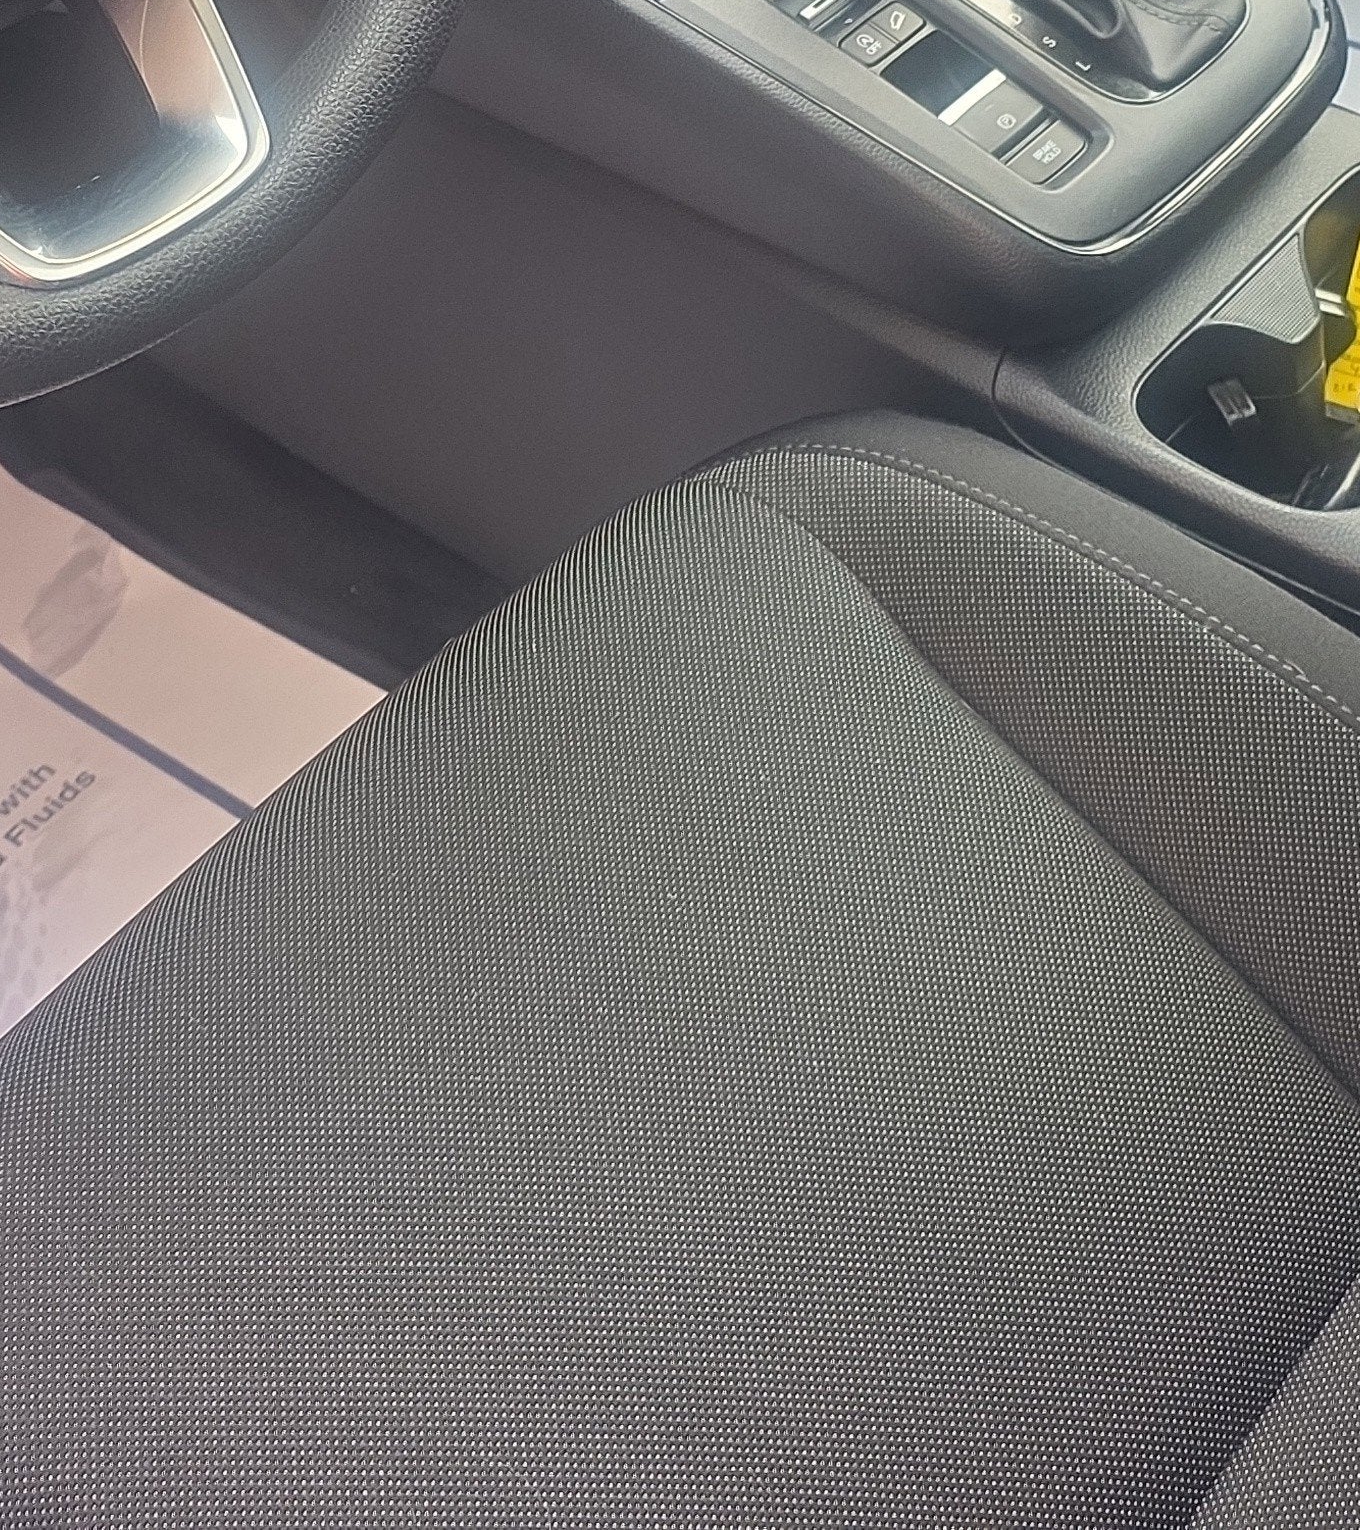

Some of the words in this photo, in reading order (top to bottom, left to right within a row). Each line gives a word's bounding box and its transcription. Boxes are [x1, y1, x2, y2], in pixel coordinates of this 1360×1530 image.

[1042, 35, 1057, 49] S
[1041, 146, 1061, 166] HOLD
[4, 767, 98, 848] Fluids
